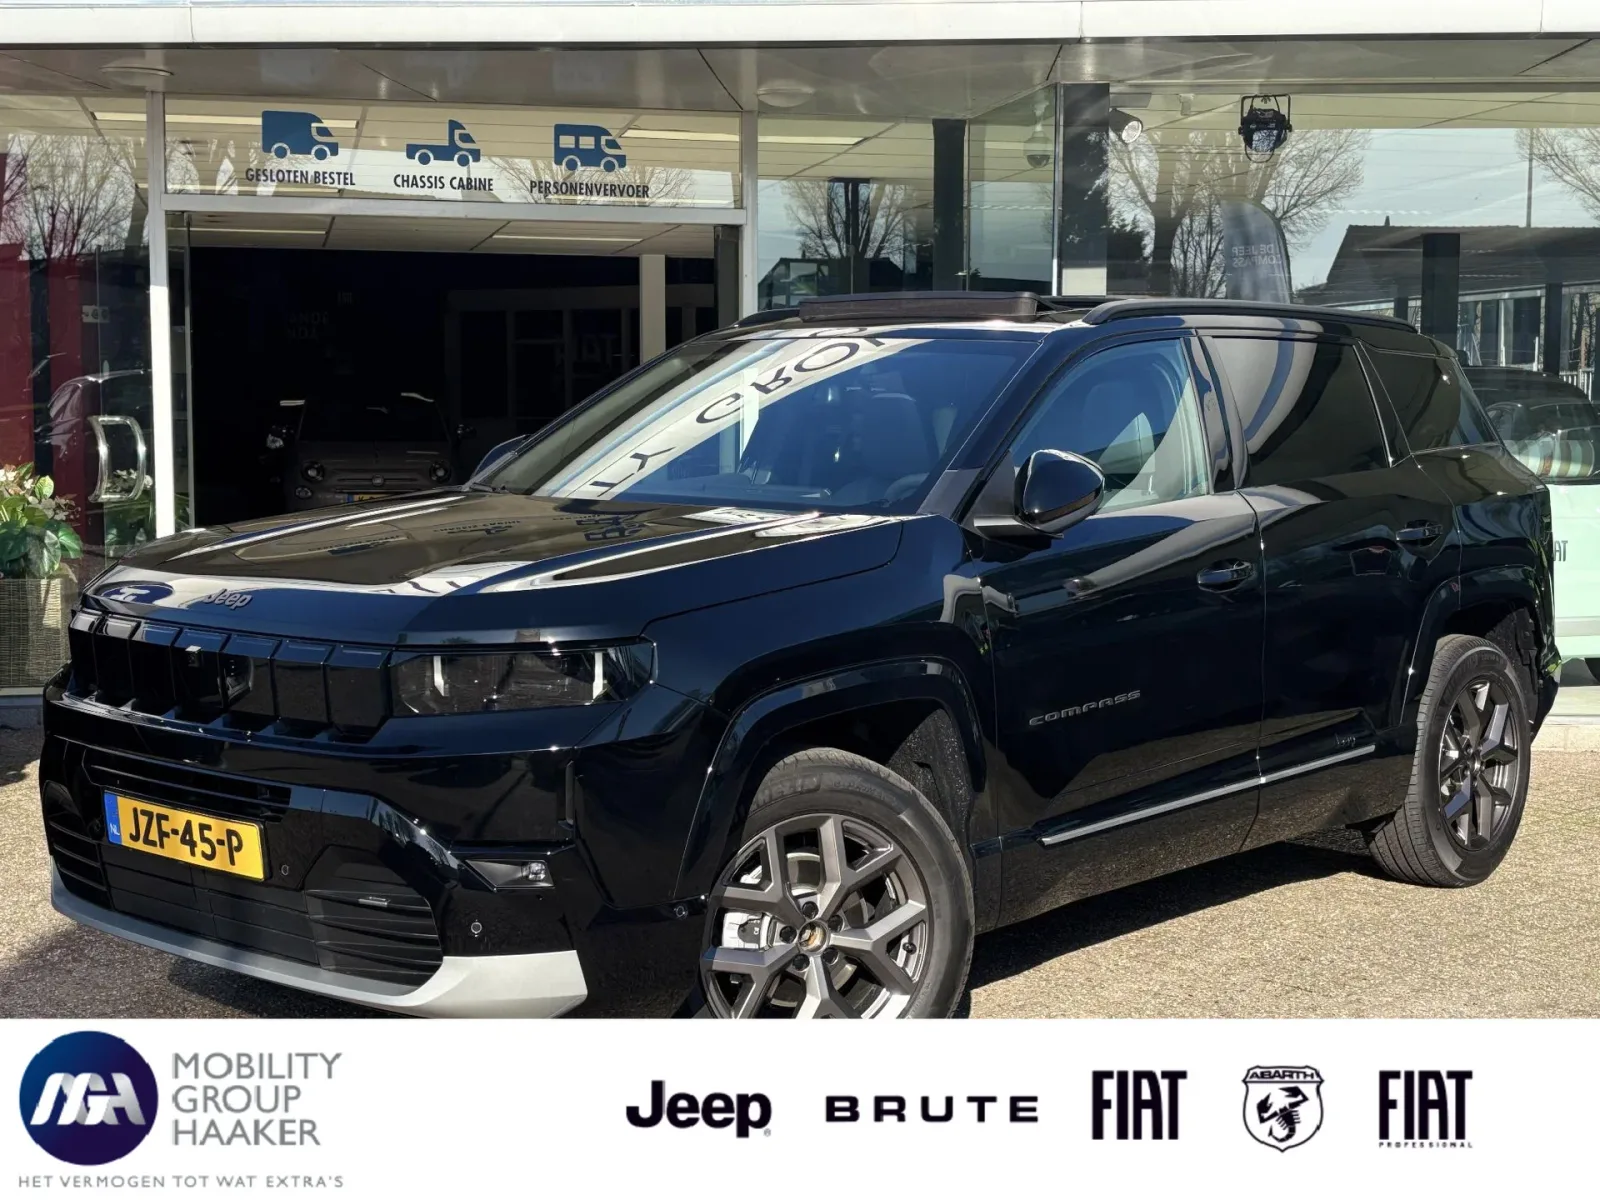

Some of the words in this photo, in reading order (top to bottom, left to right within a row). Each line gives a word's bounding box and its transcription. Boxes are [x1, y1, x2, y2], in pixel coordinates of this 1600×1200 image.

[245, 168, 309, 184] GESLOTEN
[313, 170, 356, 186] BESTEL
[393, 174, 445, 190] CHASSIS
[449, 176, 494, 191] CABINE
[529, 180, 650, 198] PERSONENVERVOER
[1553, 540, 1568, 562] AT
[203, 588, 252, 610] Jeep
[1029, 690, 1141, 726] COMPASS
[129, 807, 243, 866] JZF-45-P
